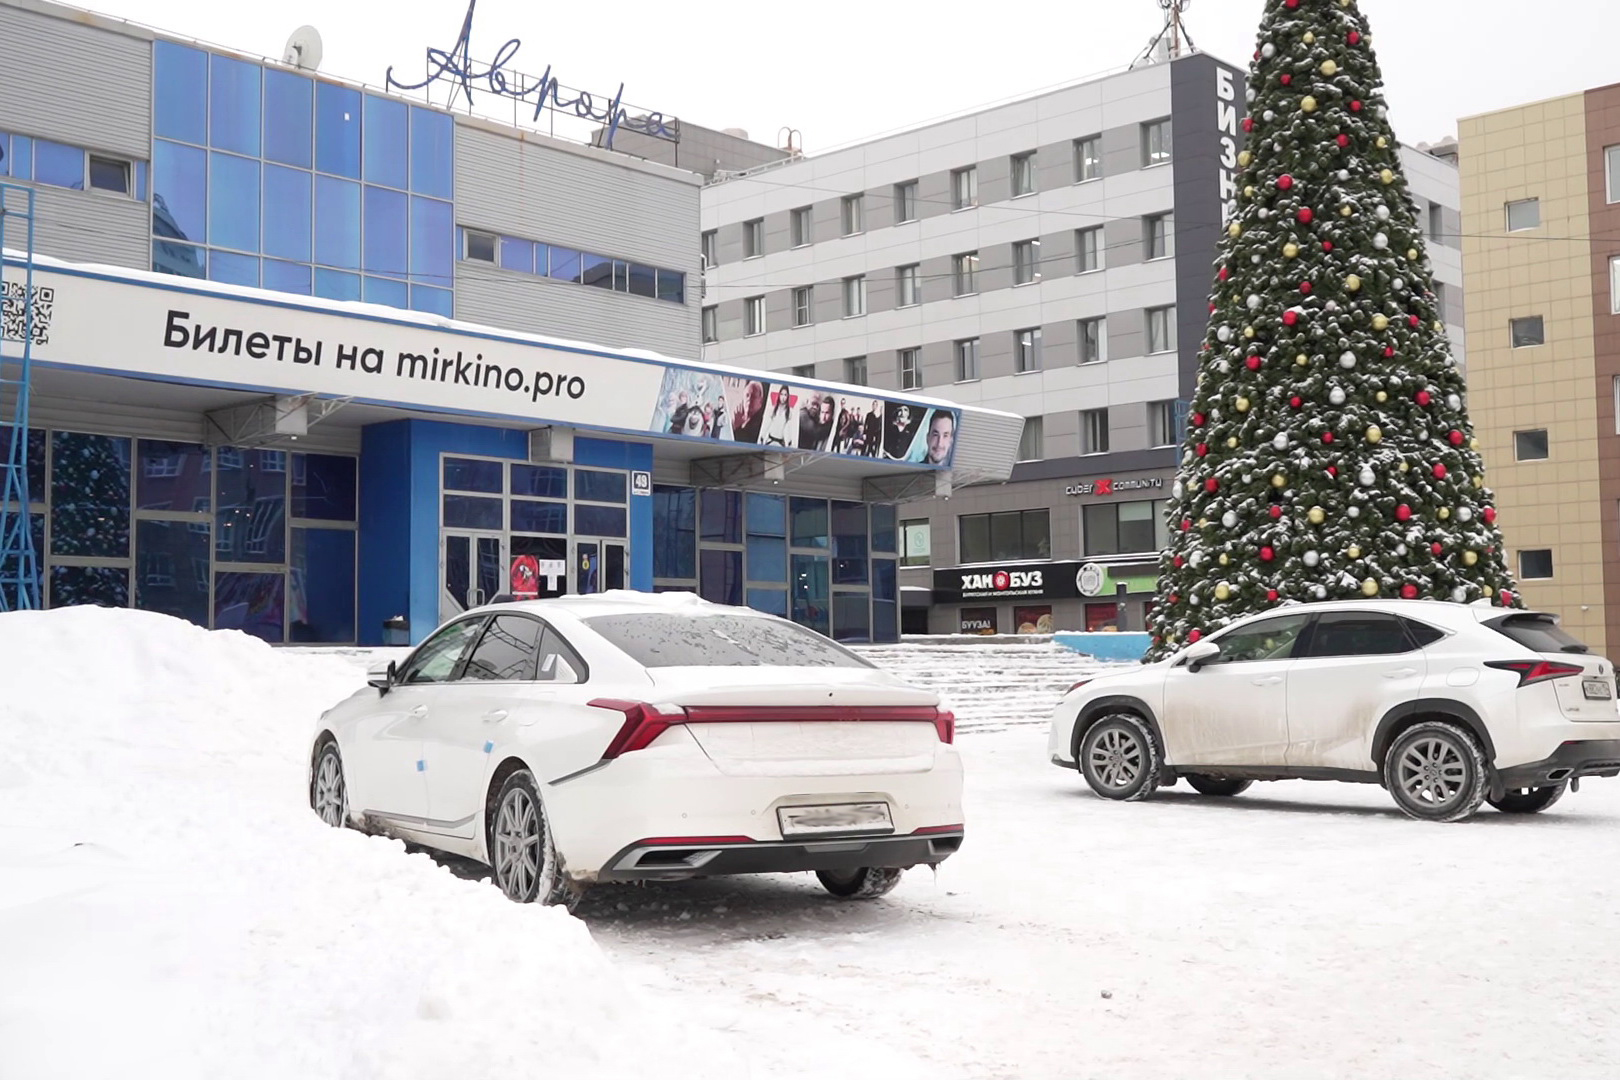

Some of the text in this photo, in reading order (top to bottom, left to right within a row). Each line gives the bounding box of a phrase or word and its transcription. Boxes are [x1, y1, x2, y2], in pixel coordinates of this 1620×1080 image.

[163, 309, 586, 403] Билеты на mirkino.pro
[961, 570, 1043, 589] ХАН БУЗ
